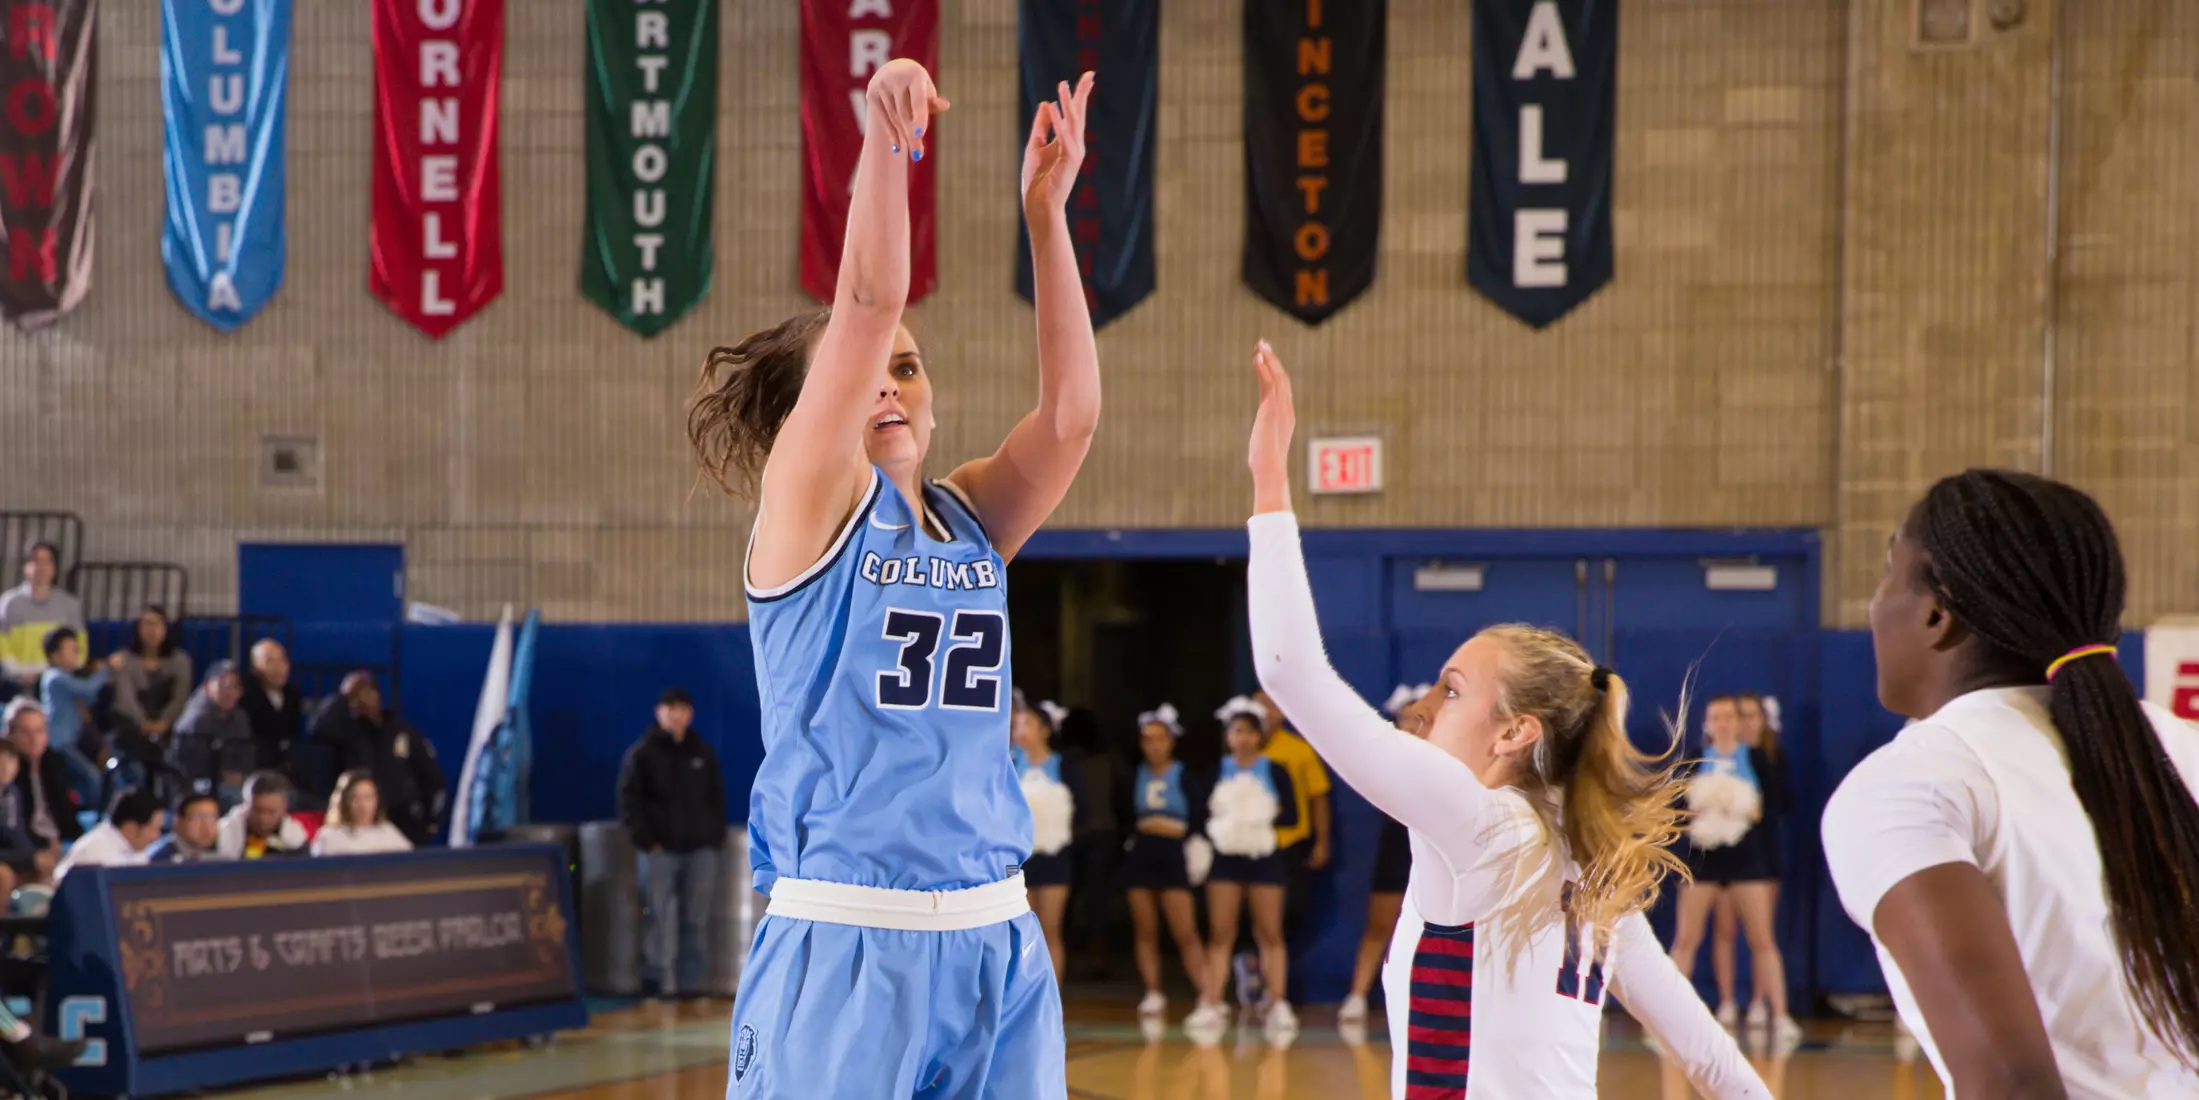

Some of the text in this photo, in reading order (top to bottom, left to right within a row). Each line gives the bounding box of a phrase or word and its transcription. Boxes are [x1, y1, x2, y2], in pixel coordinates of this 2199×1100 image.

[630, 0, 671, 315] RTMOUTH
[1512, 0, 1577, 289] ALE
[1318, 446, 1372, 489] EXIT
[876, 607, 1006, 712] 32
[1146, 780, 1168, 810] C
